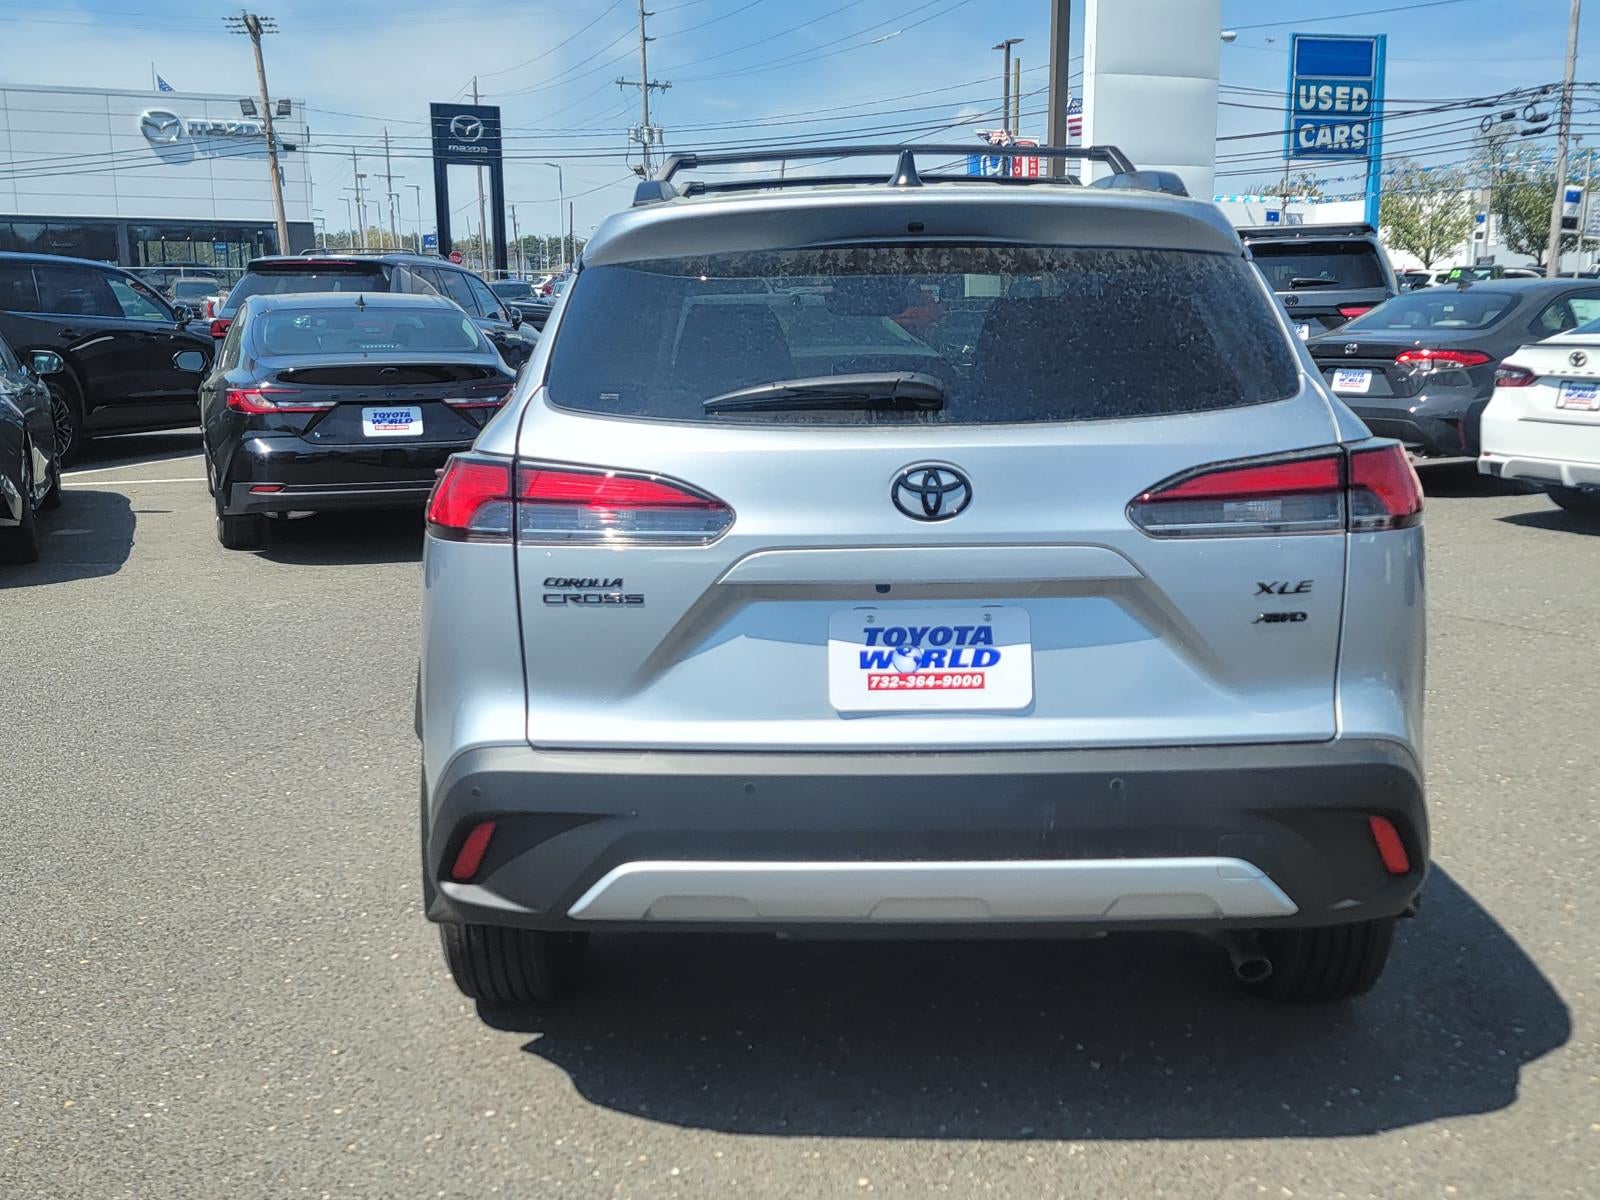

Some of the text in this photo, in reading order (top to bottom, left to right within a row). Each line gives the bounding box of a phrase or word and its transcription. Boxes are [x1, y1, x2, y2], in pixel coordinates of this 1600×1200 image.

[1299, 85, 1369, 112] USED
[1299, 123, 1366, 149] CARS
[542, 577, 623, 588] COROLLA
[1253, 579, 1315, 596] XLE
[542, 593, 645, 604] CROSS
[1250, 611, 1308, 624] AWD
[864, 625, 994, 647] TOYOTA
[859, 647, 1002, 671] WORLD
[869, 673, 983, 689] 732-364-9000
